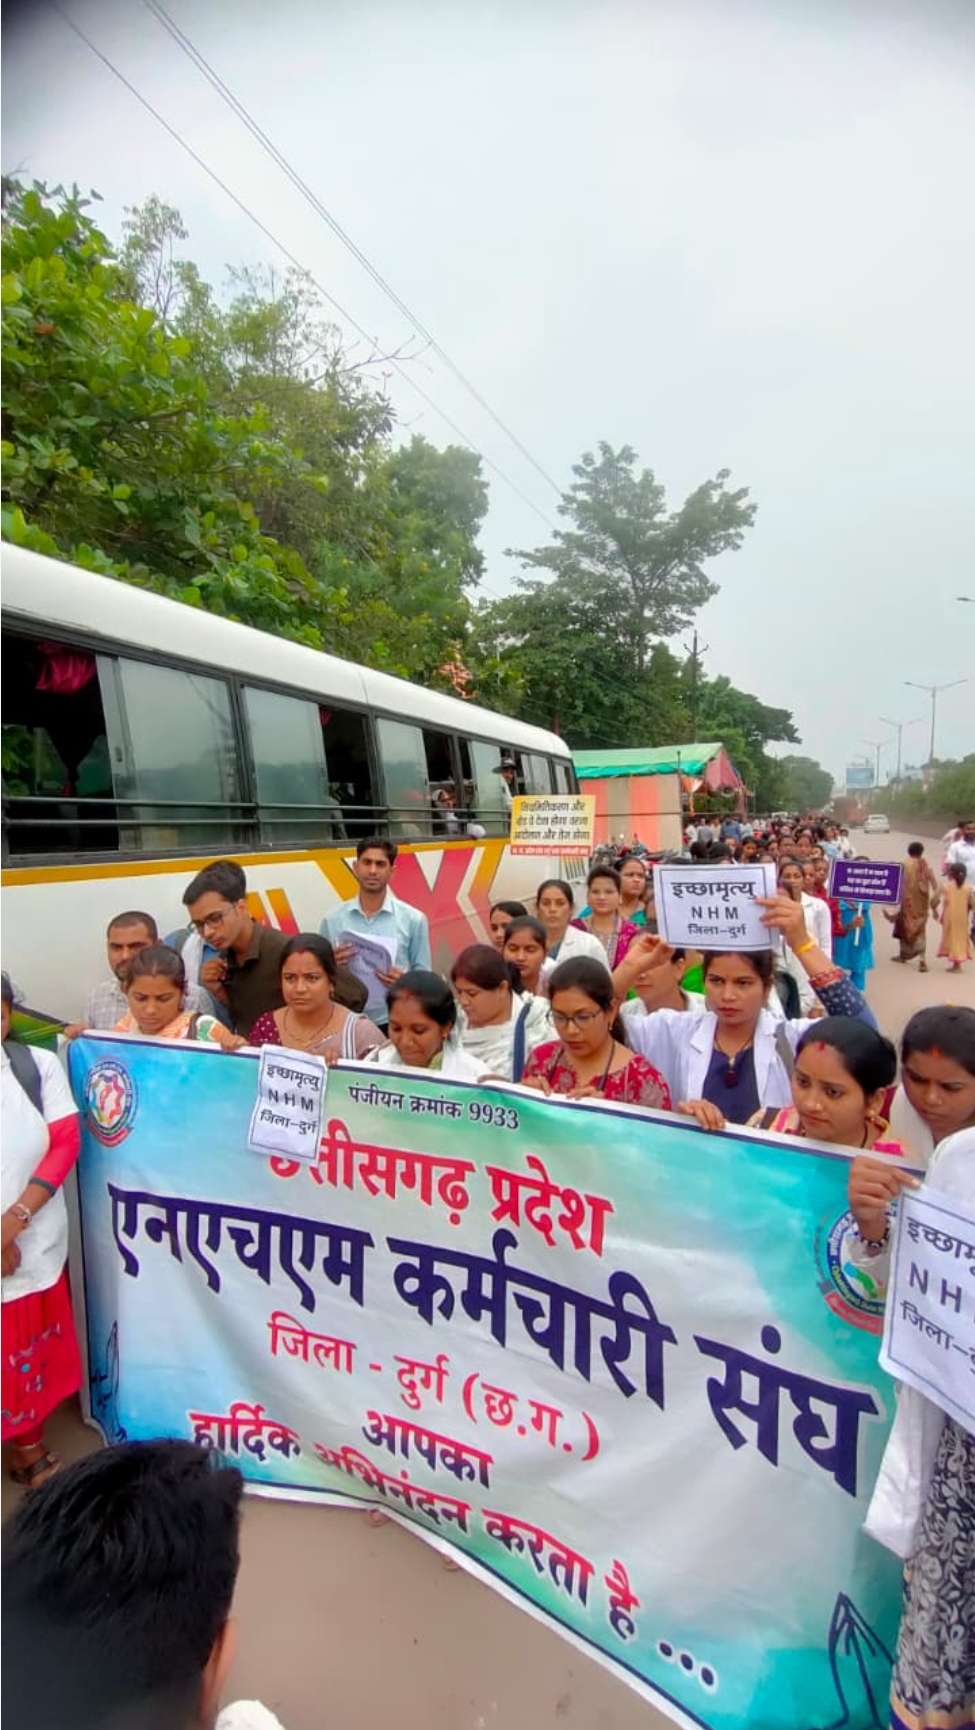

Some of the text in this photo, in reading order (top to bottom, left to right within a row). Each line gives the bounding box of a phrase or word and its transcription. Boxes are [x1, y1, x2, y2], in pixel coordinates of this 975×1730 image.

[671, 881, 756, 902] इच्छामृत्यु
[266, 1063, 320, 1092] इच्छामृत्यु
[347, 1082, 519, 1130] पंजीयन क्रमांक 9933
[485, 1154, 614, 1257] प्रदेश
[107, 1182, 879, 1499] एनएचएम कर्मचारी संघ
[267, 1310, 357, 1375] जिला
[393, 1353, 449, 1411] दुर्ग
[462, 1372, 600, 1462] (छ.ग.)
[362, 1409, 495, 1489] आपका
[189, 1401, 301, 1462] हार्दिक
[480, 1508, 596, 1608] करता
